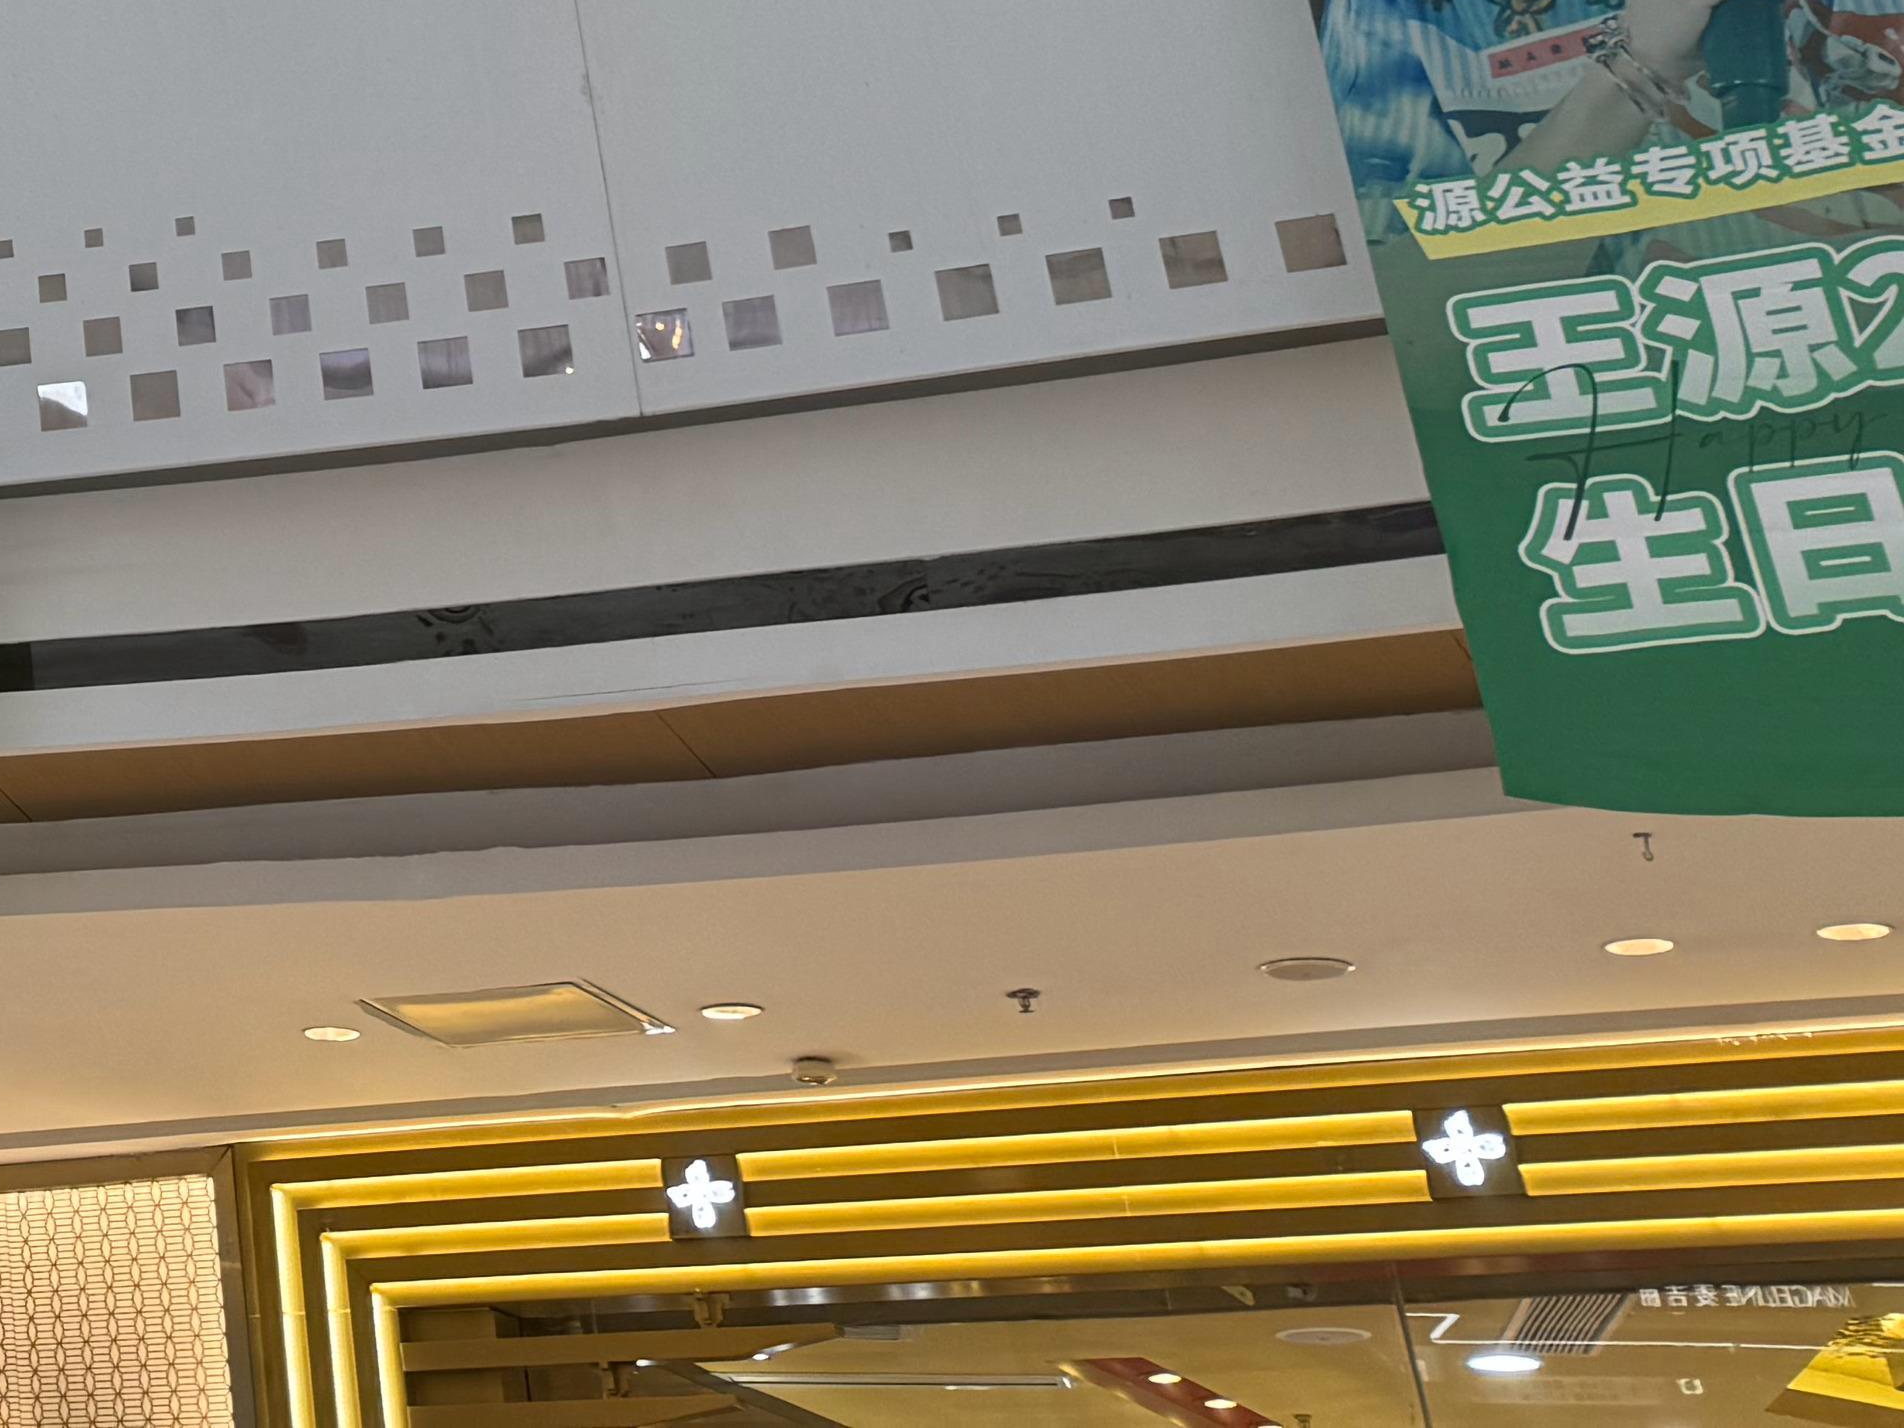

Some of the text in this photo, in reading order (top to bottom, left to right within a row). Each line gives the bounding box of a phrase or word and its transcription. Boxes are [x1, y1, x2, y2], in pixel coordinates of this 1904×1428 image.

[1415, 104, 1904, 231] 源公益专项基金
[1527, 458, 1904, 647] 生日
